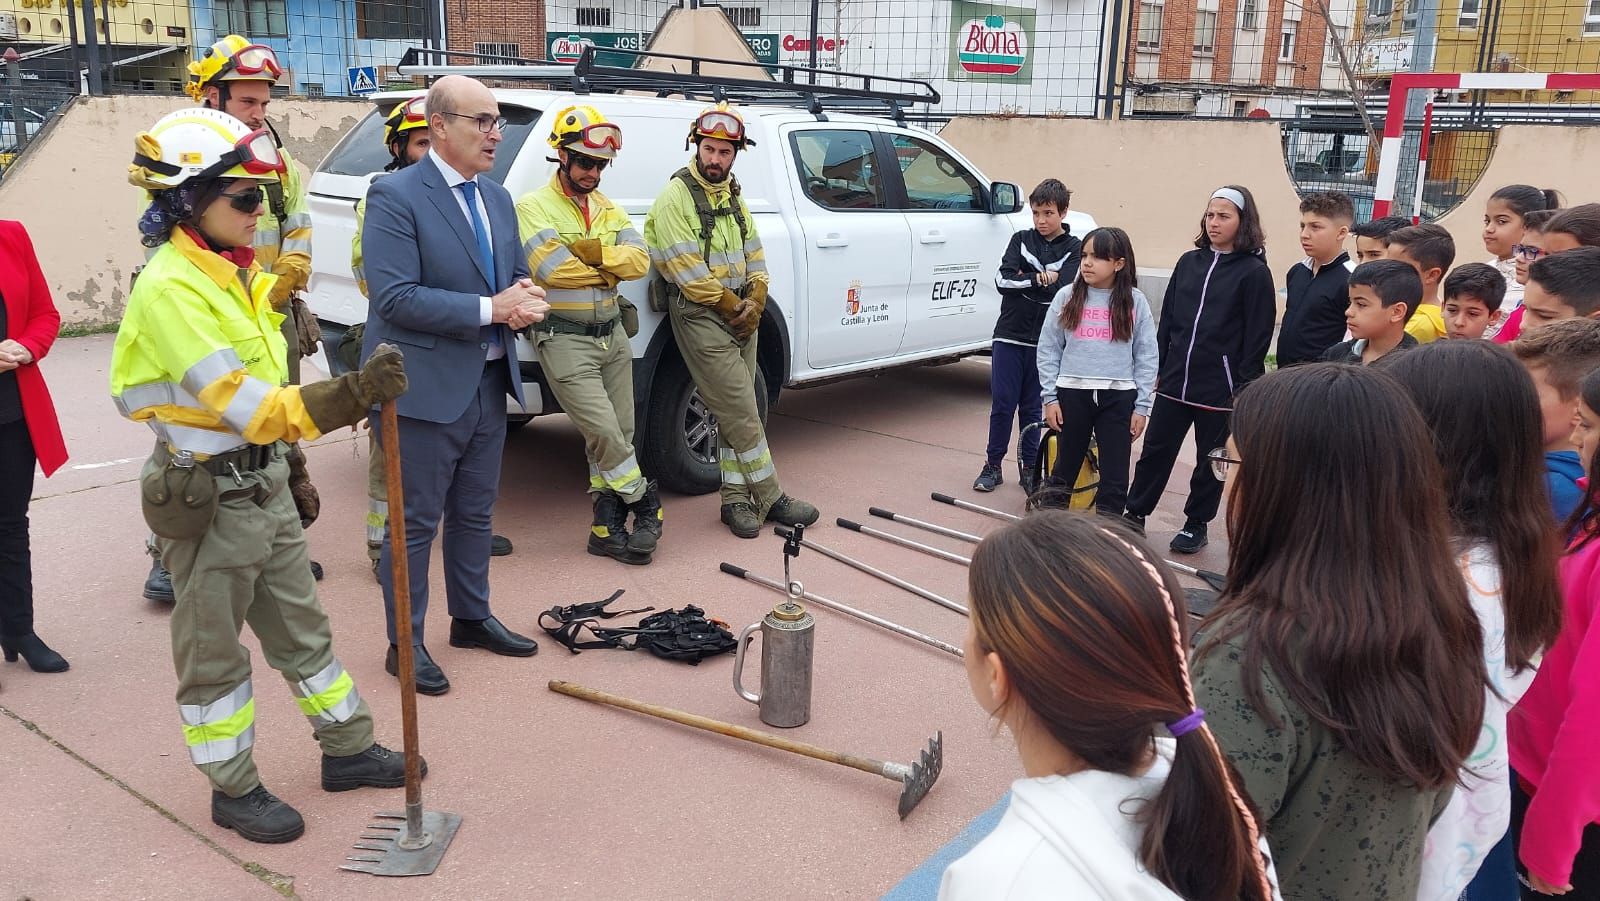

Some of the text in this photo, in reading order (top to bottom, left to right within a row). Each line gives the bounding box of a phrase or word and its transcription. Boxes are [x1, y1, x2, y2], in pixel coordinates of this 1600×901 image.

[965, 24, 1020, 55] Biona
[558, 40, 583, 54] Bion
[932, 278, 977, 301] ELIF-Z3
[860, 303, 889, 314] Junta de
[841, 313, 889, 326] Castilla y León
